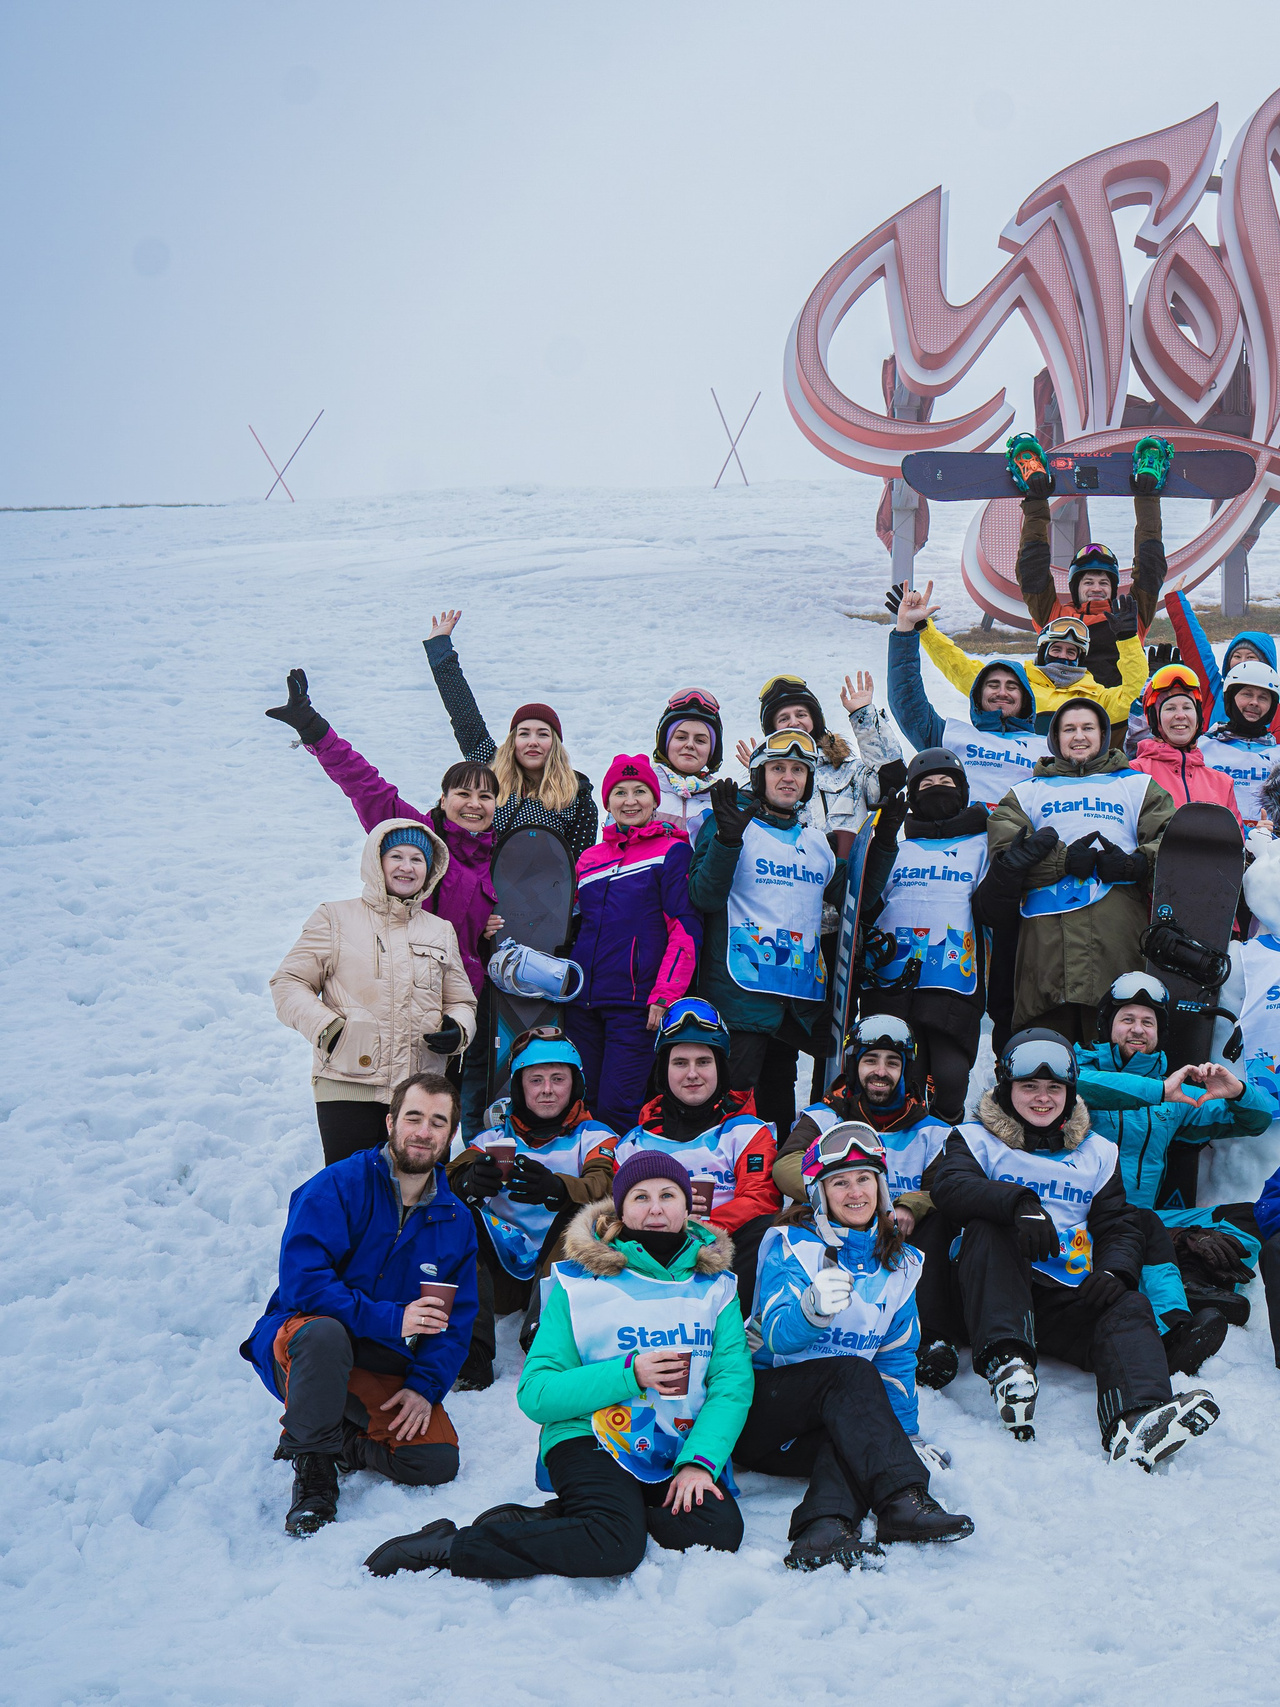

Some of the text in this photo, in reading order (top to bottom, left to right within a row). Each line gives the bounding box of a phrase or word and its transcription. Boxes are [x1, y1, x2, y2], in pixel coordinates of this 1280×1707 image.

[1212, 765, 1270, 781] tarLi
[1041, 797, 1124, 819] StarLine
[755, 858, 825, 885] StarLine
[892, 865, 974, 884] StarLine
[886, 1171, 922, 1191] Line
[616, 1322, 714, 1351] StarLin
